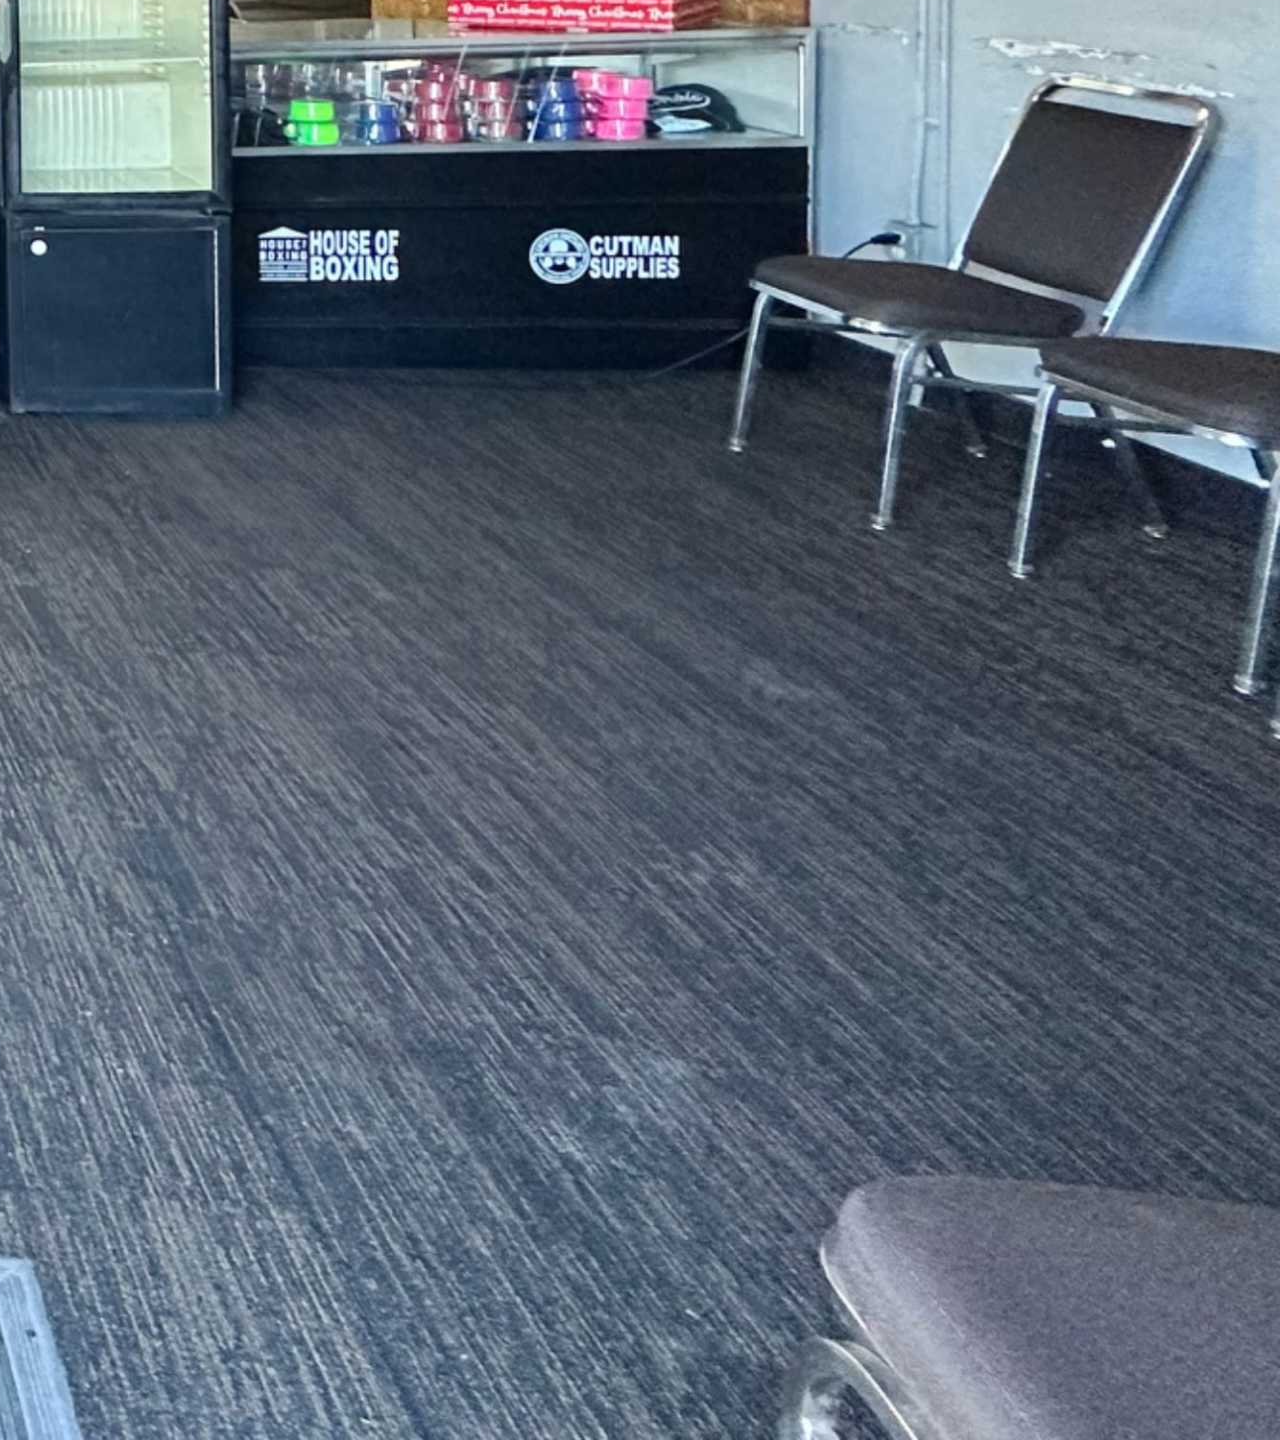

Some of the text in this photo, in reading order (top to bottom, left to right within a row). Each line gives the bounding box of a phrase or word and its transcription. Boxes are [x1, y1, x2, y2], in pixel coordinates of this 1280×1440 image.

[309, 229, 400, 256] HOUSE OF
[589, 235, 680, 256] CUTMAN
[309, 256, 400, 281] BOXING
[589, 256, 680, 279] SUPPLIES
